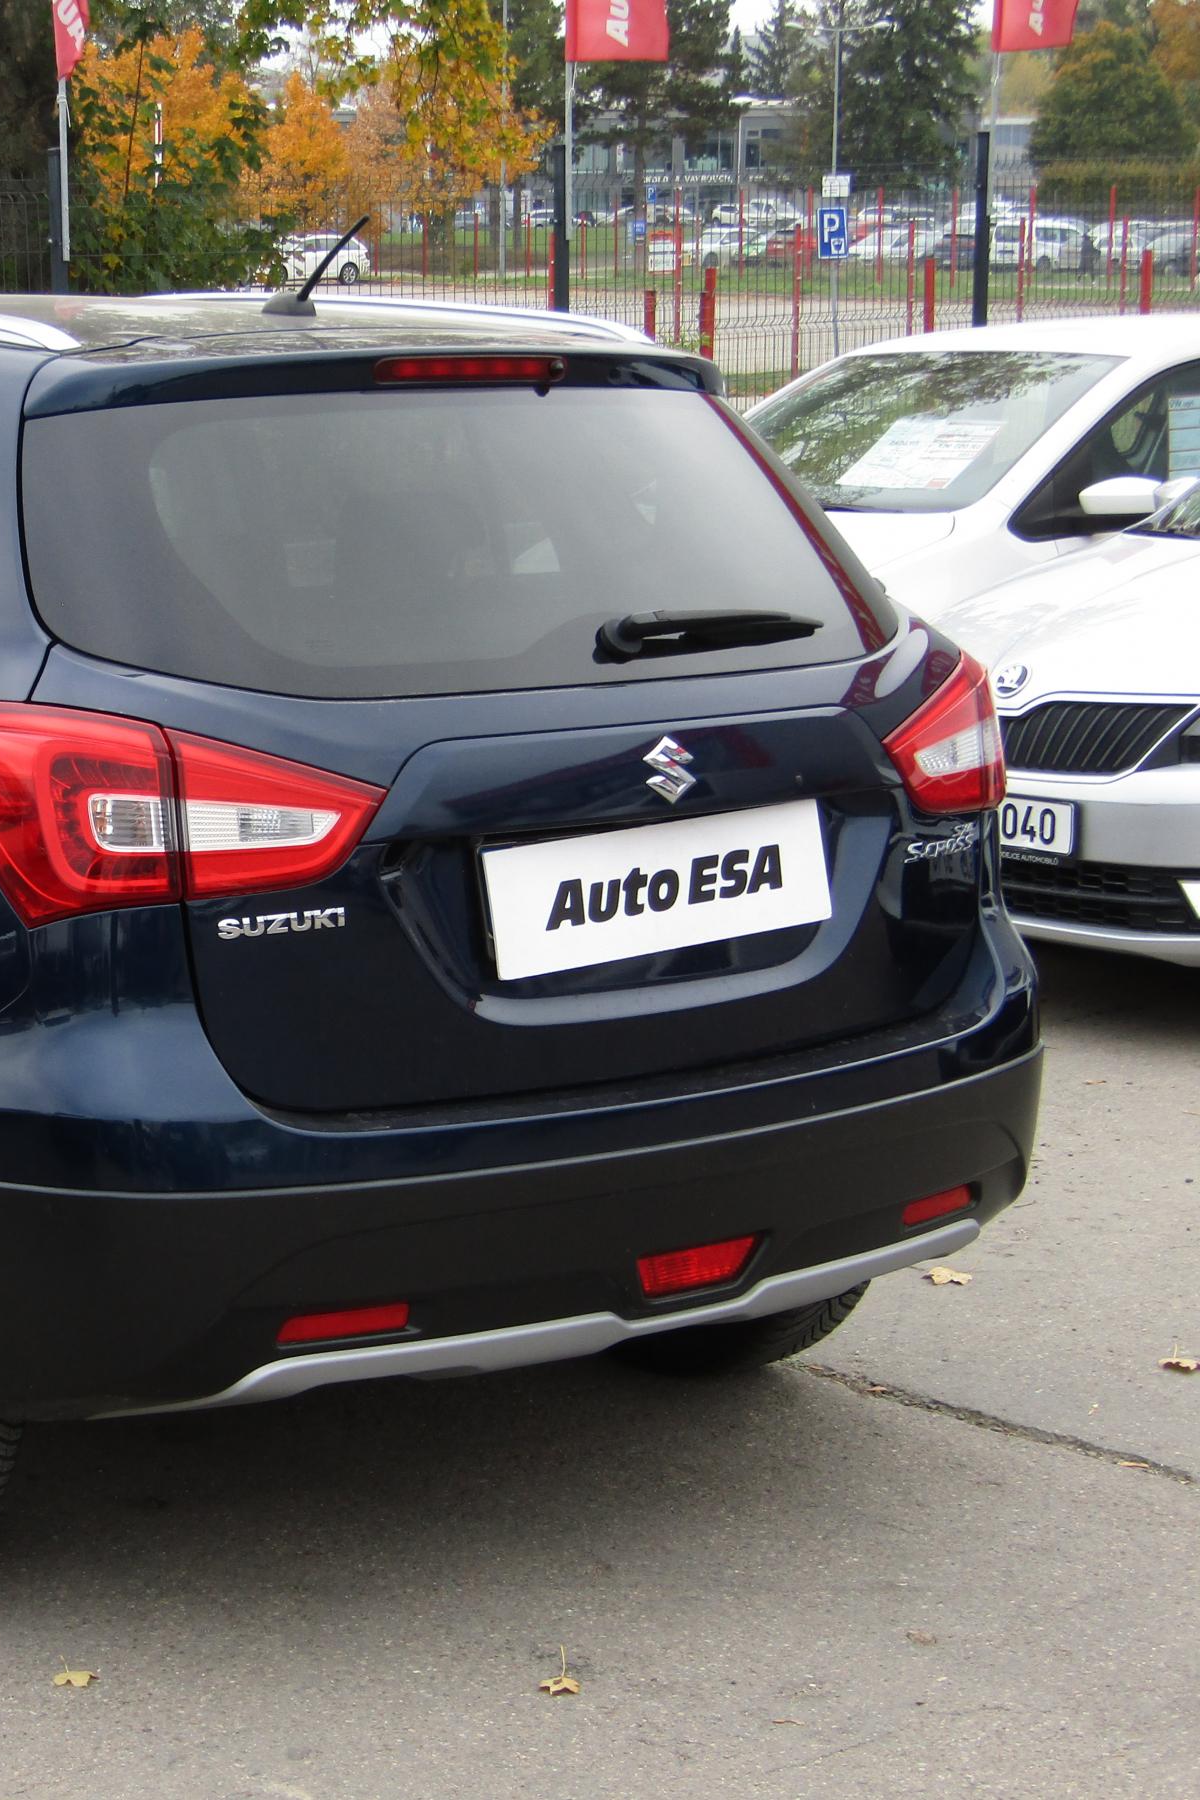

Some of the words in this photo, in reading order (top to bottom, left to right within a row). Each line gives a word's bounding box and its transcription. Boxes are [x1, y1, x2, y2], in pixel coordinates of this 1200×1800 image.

[824, 213, 840, 243] P
[1002, 803, 1056, 845] 040
[546, 867, 680, 931] Auto
[688, 844, 783, 905] ESA
[217, 907, 346, 940] SUZUKI
